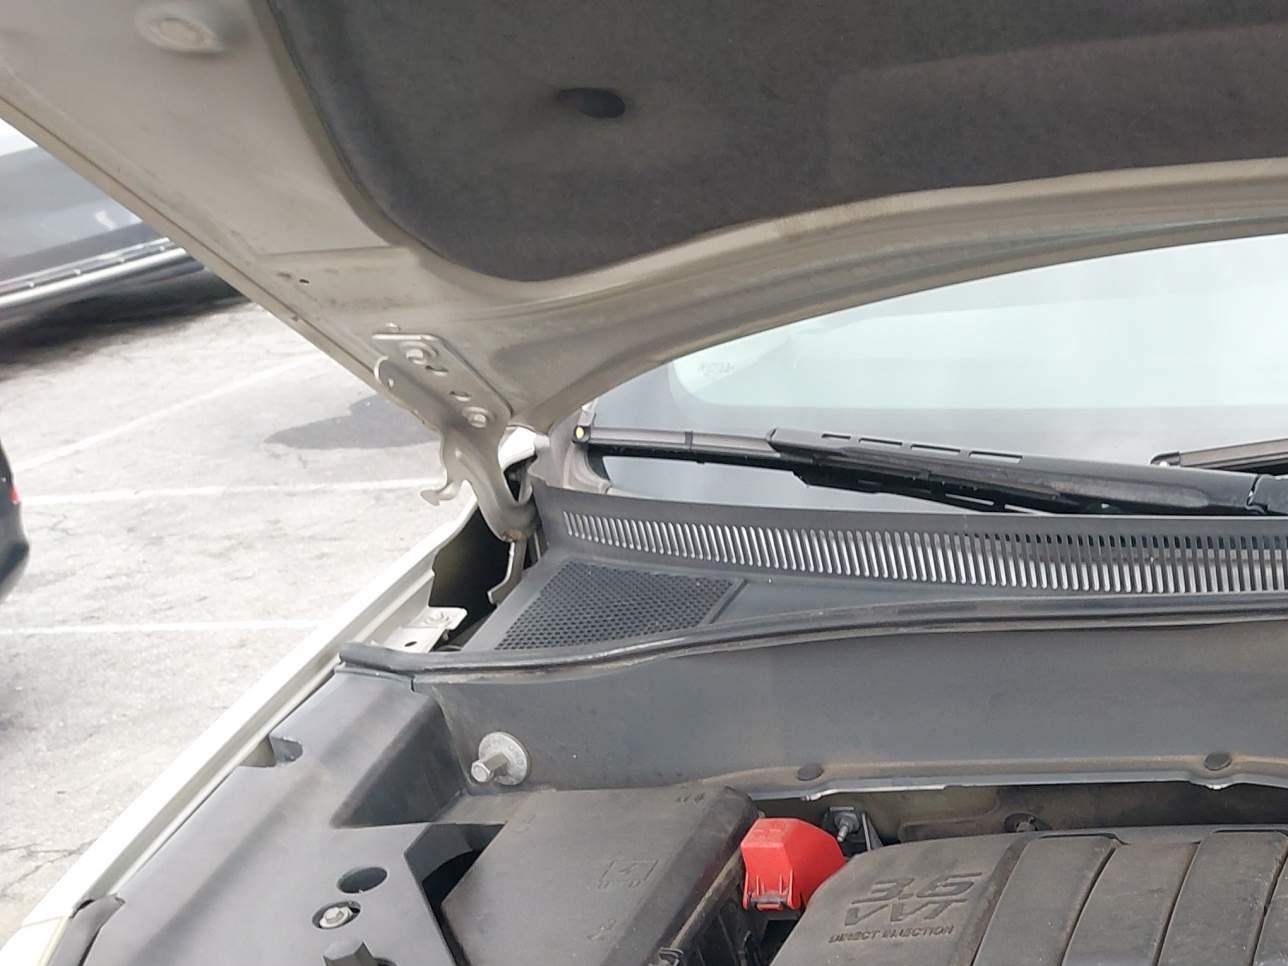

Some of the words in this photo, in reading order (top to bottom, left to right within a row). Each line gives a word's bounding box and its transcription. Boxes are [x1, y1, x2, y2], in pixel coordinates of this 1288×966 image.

[852, 872, 982, 904] 3.6
[844, 898, 968, 926] VVT
[828, 930, 880, 943] DIRECT
[882, 925, 954, 939] INJECTION
